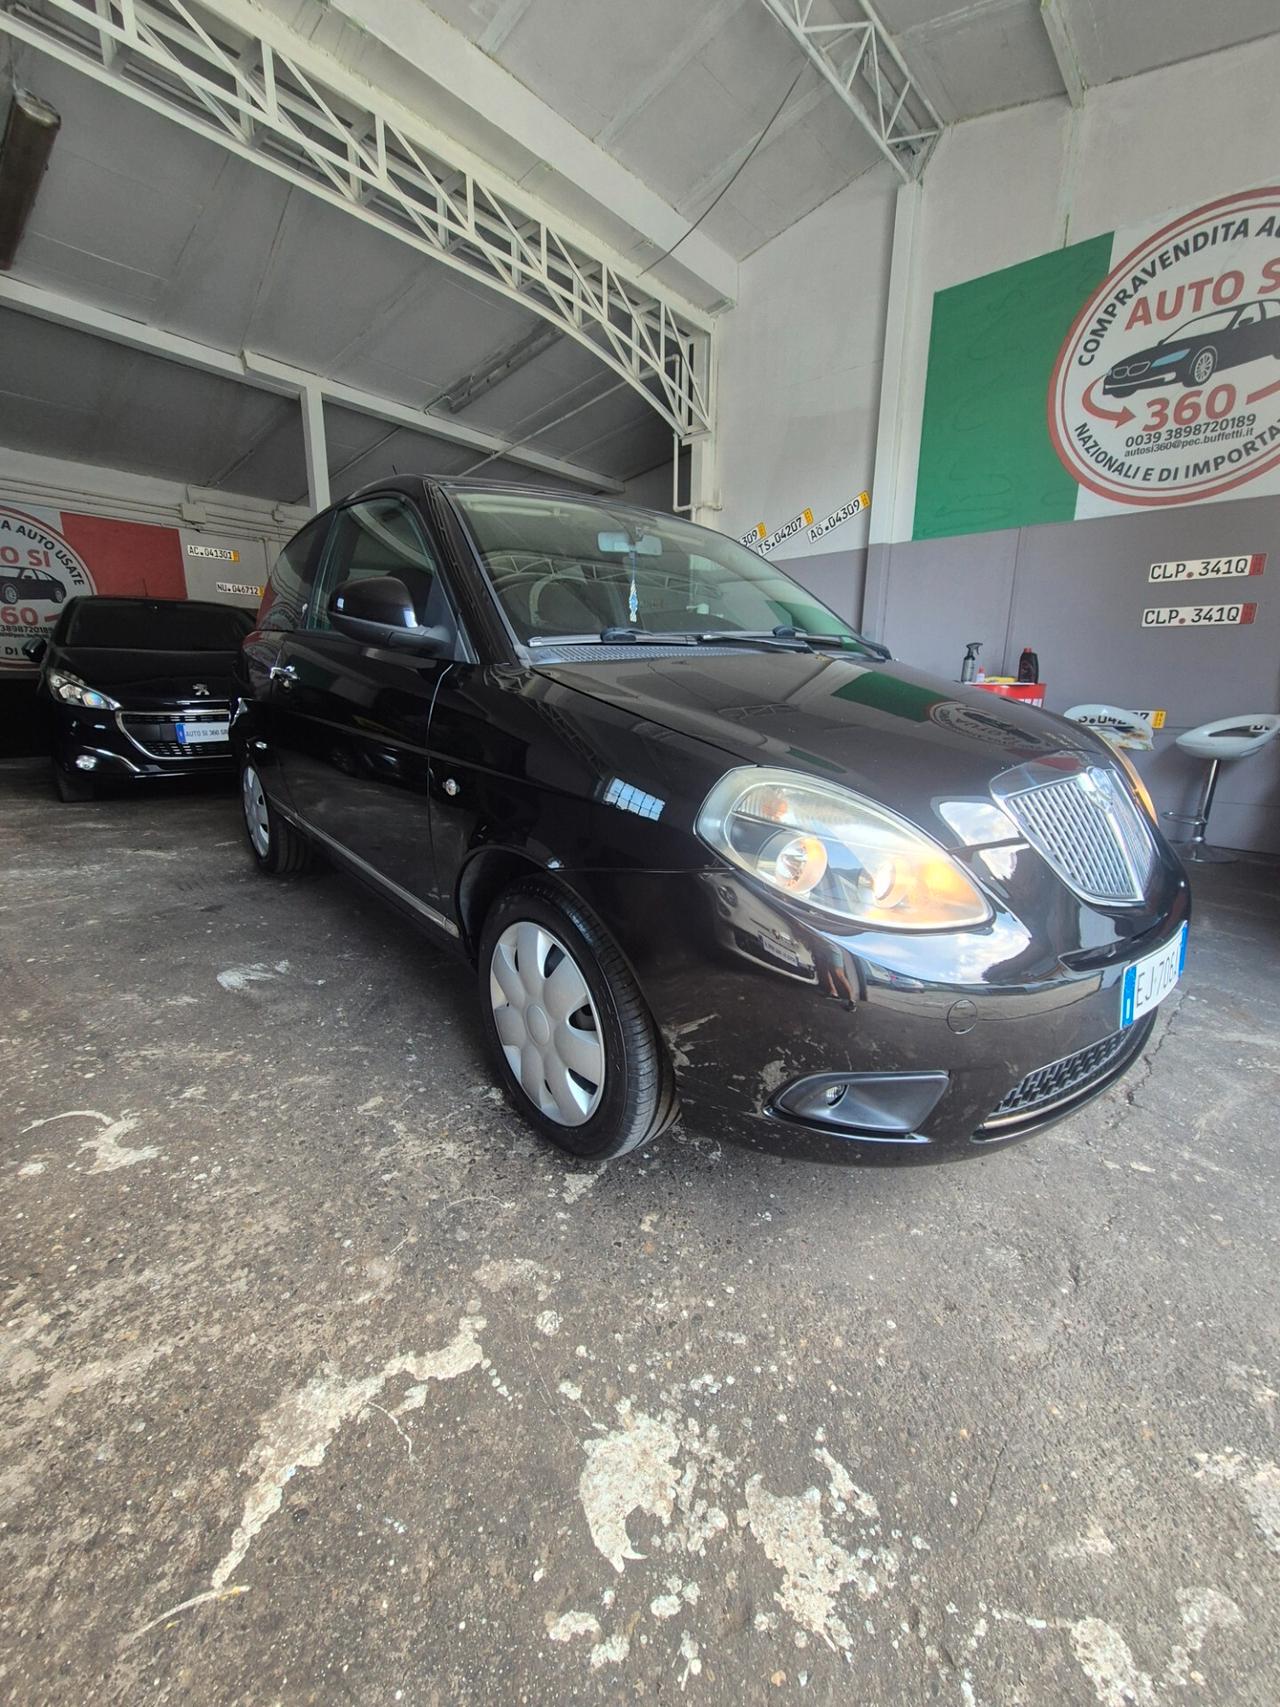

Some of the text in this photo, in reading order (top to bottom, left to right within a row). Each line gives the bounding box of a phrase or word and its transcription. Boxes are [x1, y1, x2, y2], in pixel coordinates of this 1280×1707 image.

[1078, 217, 1249, 366] COMPRAVENDITA
[1124, 270, 1245, 331] AUTO
[1125, 413, 1257, 449] 0039 3898720189
[1142, 383, 1237, 433] 360
[1074, 418, 1280, 482] NAZIONALI E DI IMPORTA
[1124, 427, 1255, 458] autosi360@pec.buffetti.it
[16, 525, 55, 551] AUTO
[55, 549, 85, 586] USATE
[27, 548, 51, 568] SI
